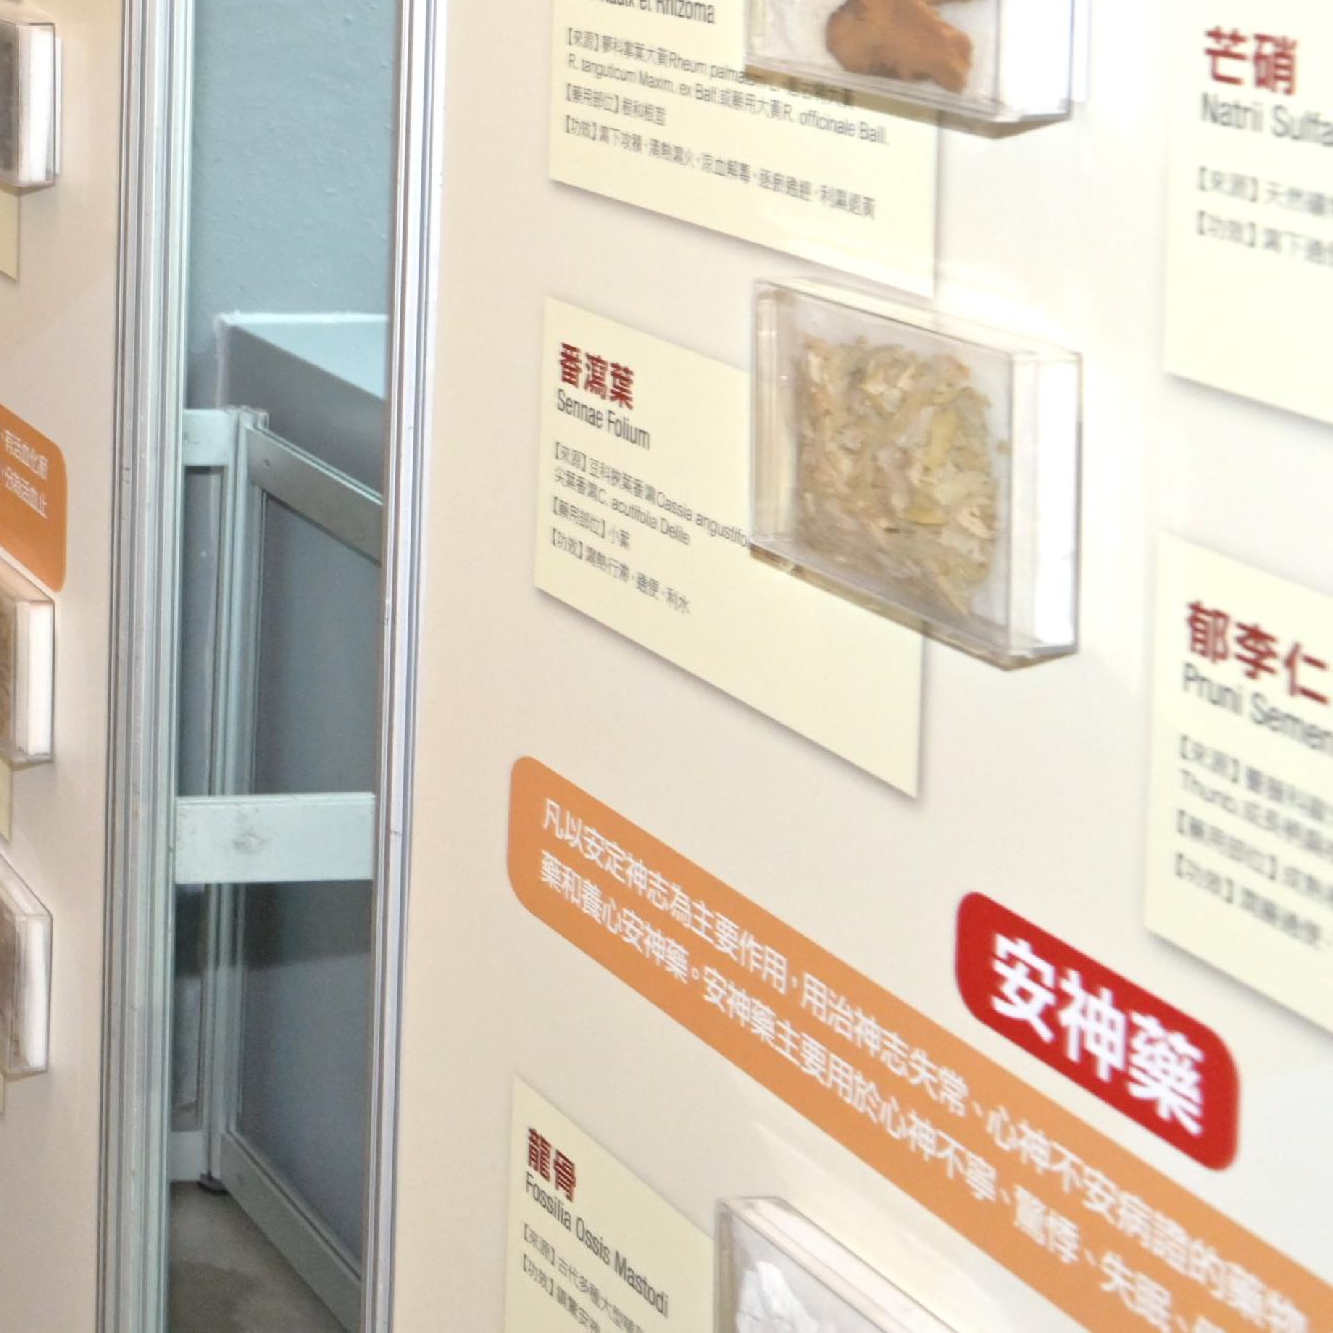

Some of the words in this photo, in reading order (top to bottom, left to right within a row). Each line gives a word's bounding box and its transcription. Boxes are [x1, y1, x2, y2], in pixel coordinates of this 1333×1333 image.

[1204, 26, 1298, 97] 芒硝
[559, 342, 635, 411] 番瀉葉
[557, 388, 603, 431] Sennae
[607, 409, 651, 451] Folium
[1183, 660, 1244, 716] Pruni
[1187, 600, 1330, 706] 郁李仁
[989, 932, 1206, 1136] 安神藥
[528, 1127, 577, 1203] 龍骨
[526, 1170, 571, 1232] Fossilia
[576, 1217, 611, 1266] Ossis
[614, 1249, 670, 1319] Mastodi
